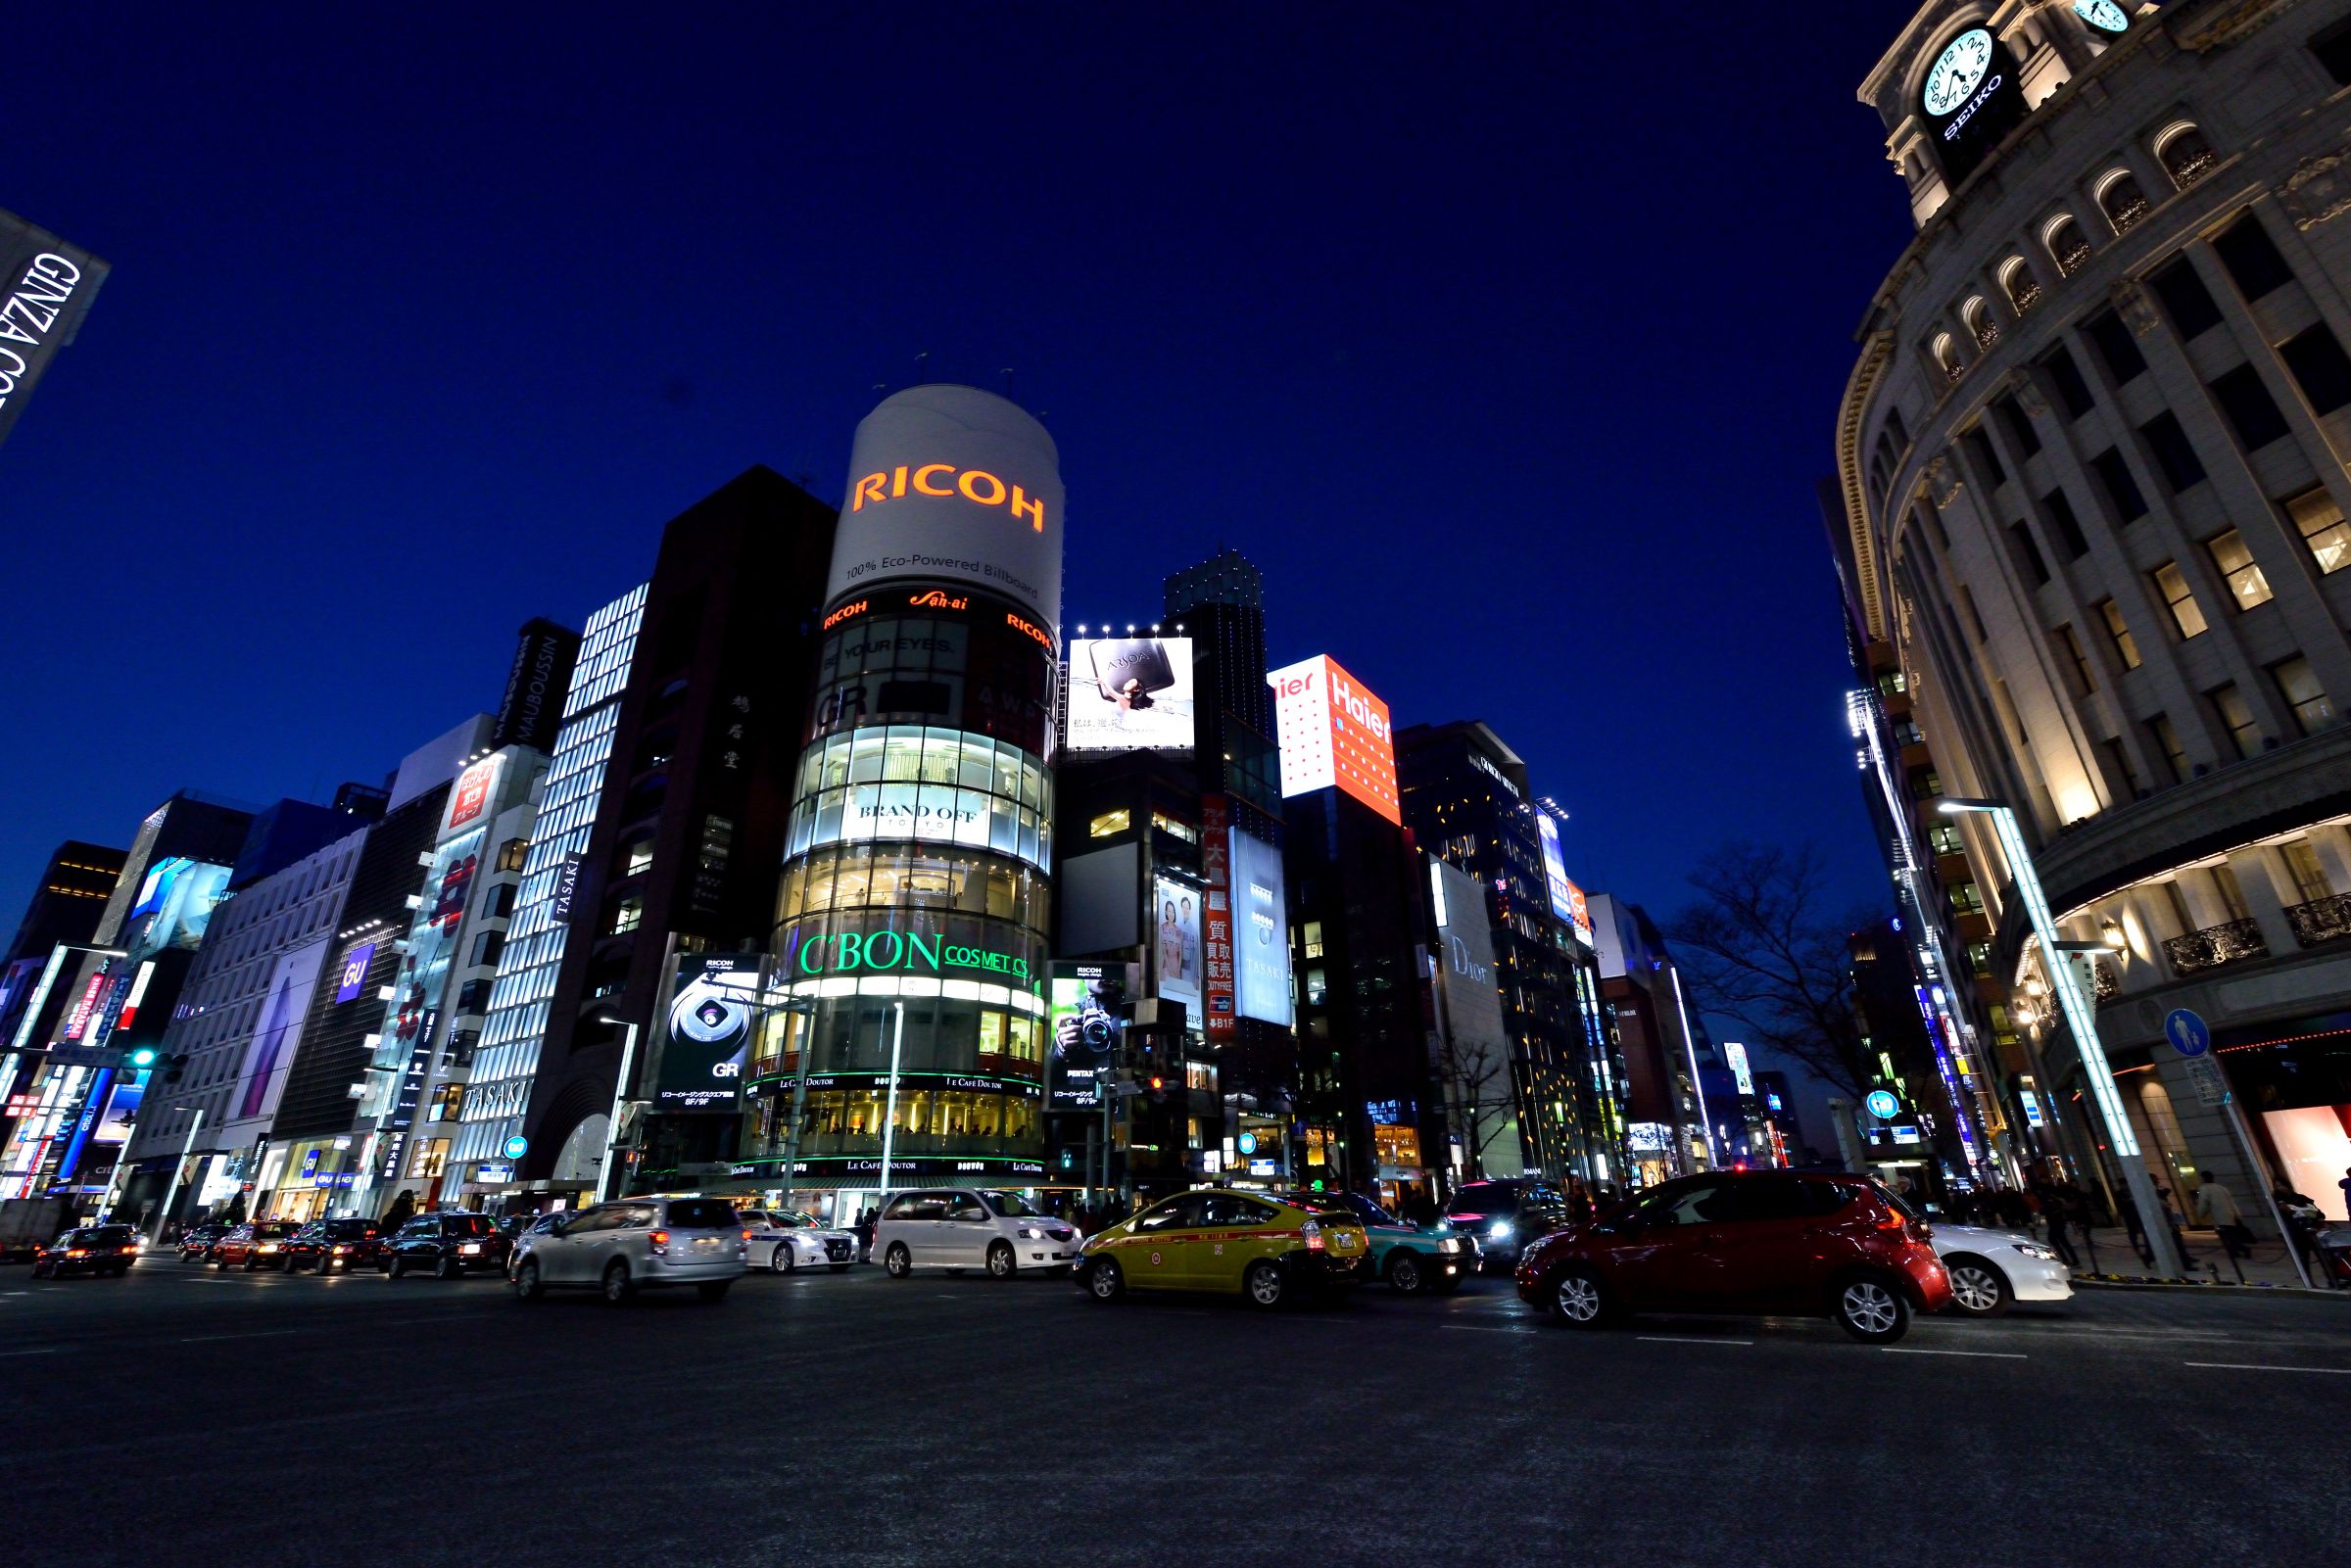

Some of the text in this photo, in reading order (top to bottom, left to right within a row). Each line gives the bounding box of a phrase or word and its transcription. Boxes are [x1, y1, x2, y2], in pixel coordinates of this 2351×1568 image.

[1957, 43, 1964, 52] 1
[1967, 36, 1978, 49] 2
[1975, 40, 1986, 53] 3
[1943, 51, 1955, 66] 12
[1976, 53, 1986, 66] 4
[1935, 65, 1945, 78] 11
[1970, 70, 1981, 82] 5
[1931, 79, 1942, 93] 10
[1960, 82, 1971, 95] 6
[1943, 74, 2002, 141] SEIKO
[0, 253, 80, 346] GINZA
[853, 463, 1043, 533] RICOH
[846, 554, 1038, 599] 100% Eco-Powered Billboard
[909, 591, 969, 610] San-ai
[823, 600, 868, 630] RICOH
[1007, 613, 1051, 648] RICOH
[843, 639, 892, 659] YOUR
[1108, 651, 1150, 671] ARSOA
[517, 636, 557, 741] MAUBOUSSIN
[1275, 673, 1314, 700] ier
[1331, 672, 1391, 745] Haier
[454, 802, 479, 823] グループ
[860, 805, 977, 823] BRAND OFF
[888, 820, 944, 829] TOYO
[556, 859, 579, 915] TASAKI
[1207, 843, 1226, 911] 大黒屋
[1209, 920, 1227, 941] 質
[800, 931, 1029, 977] C'BON COSMETCS
[1207, 942, 1230, 960] 買取
[343, 959, 367, 985] GU
[1207, 961, 1231, 979] 販売
[1246, 958, 1283, 980] TASAKI
[1217, 1018, 1234, 1028] B1F
[712, 1063, 739, 1077] GR
[464, 1079, 526, 1111] TASAKI
[306, 1158, 316, 1169] GU
[847, 1161, 858, 1169] LE
[860, 1161, 882, 1169] CAFÉ
